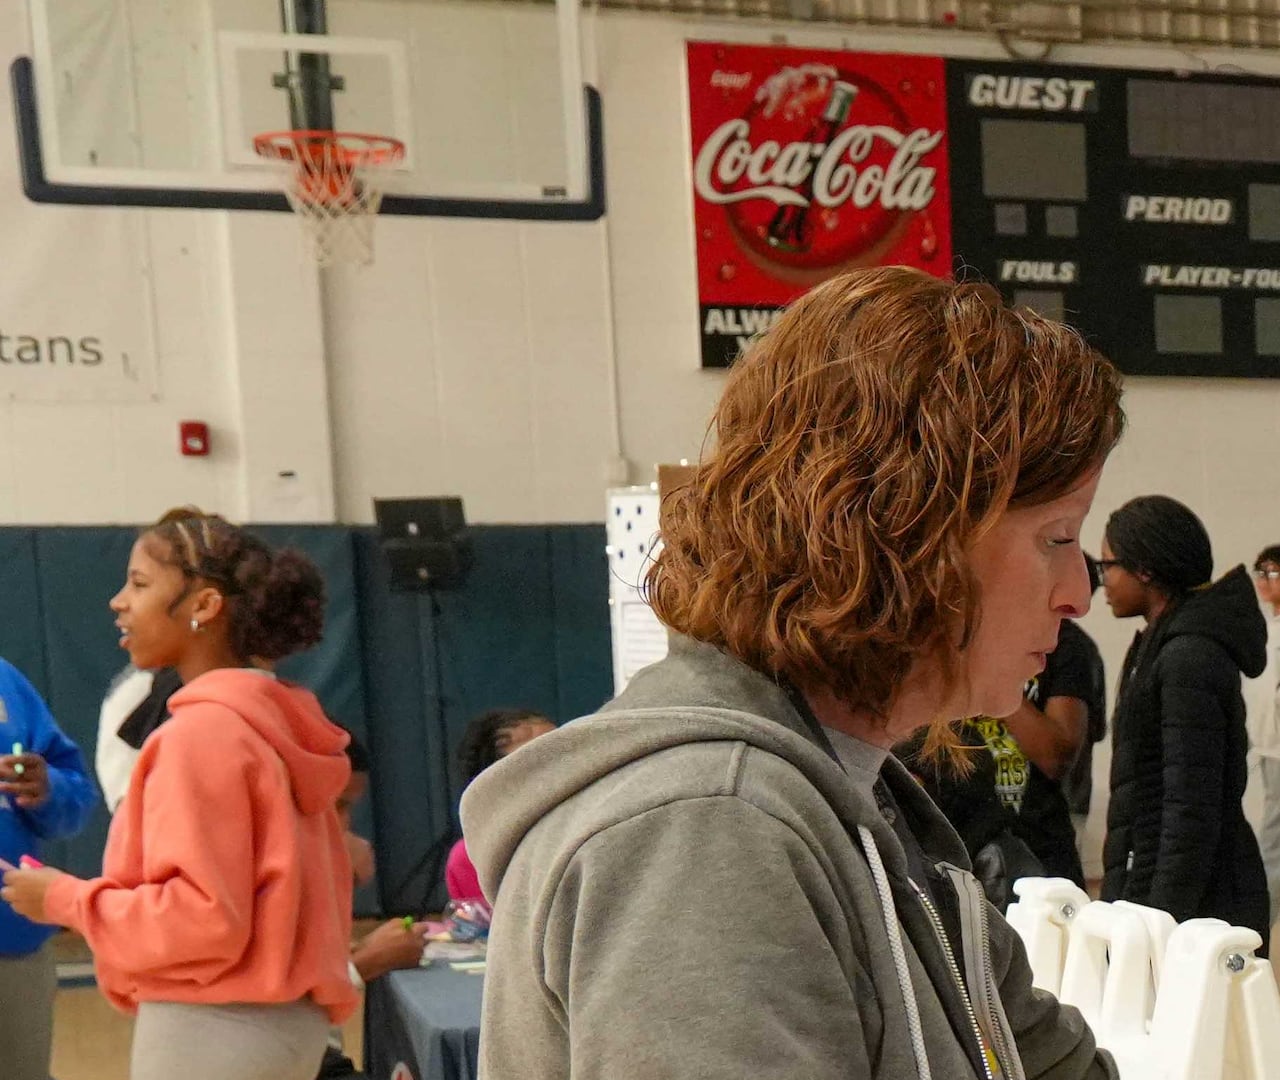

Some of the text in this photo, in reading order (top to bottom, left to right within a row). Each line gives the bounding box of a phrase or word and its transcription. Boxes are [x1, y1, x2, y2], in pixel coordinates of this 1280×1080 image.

[969, 73, 1096, 112] GUEST
[695, 118, 944, 211] Coca-Cola
[1124, 194, 1232, 225] PERIOD
[1002, 260, 1075, 283] FOULS
